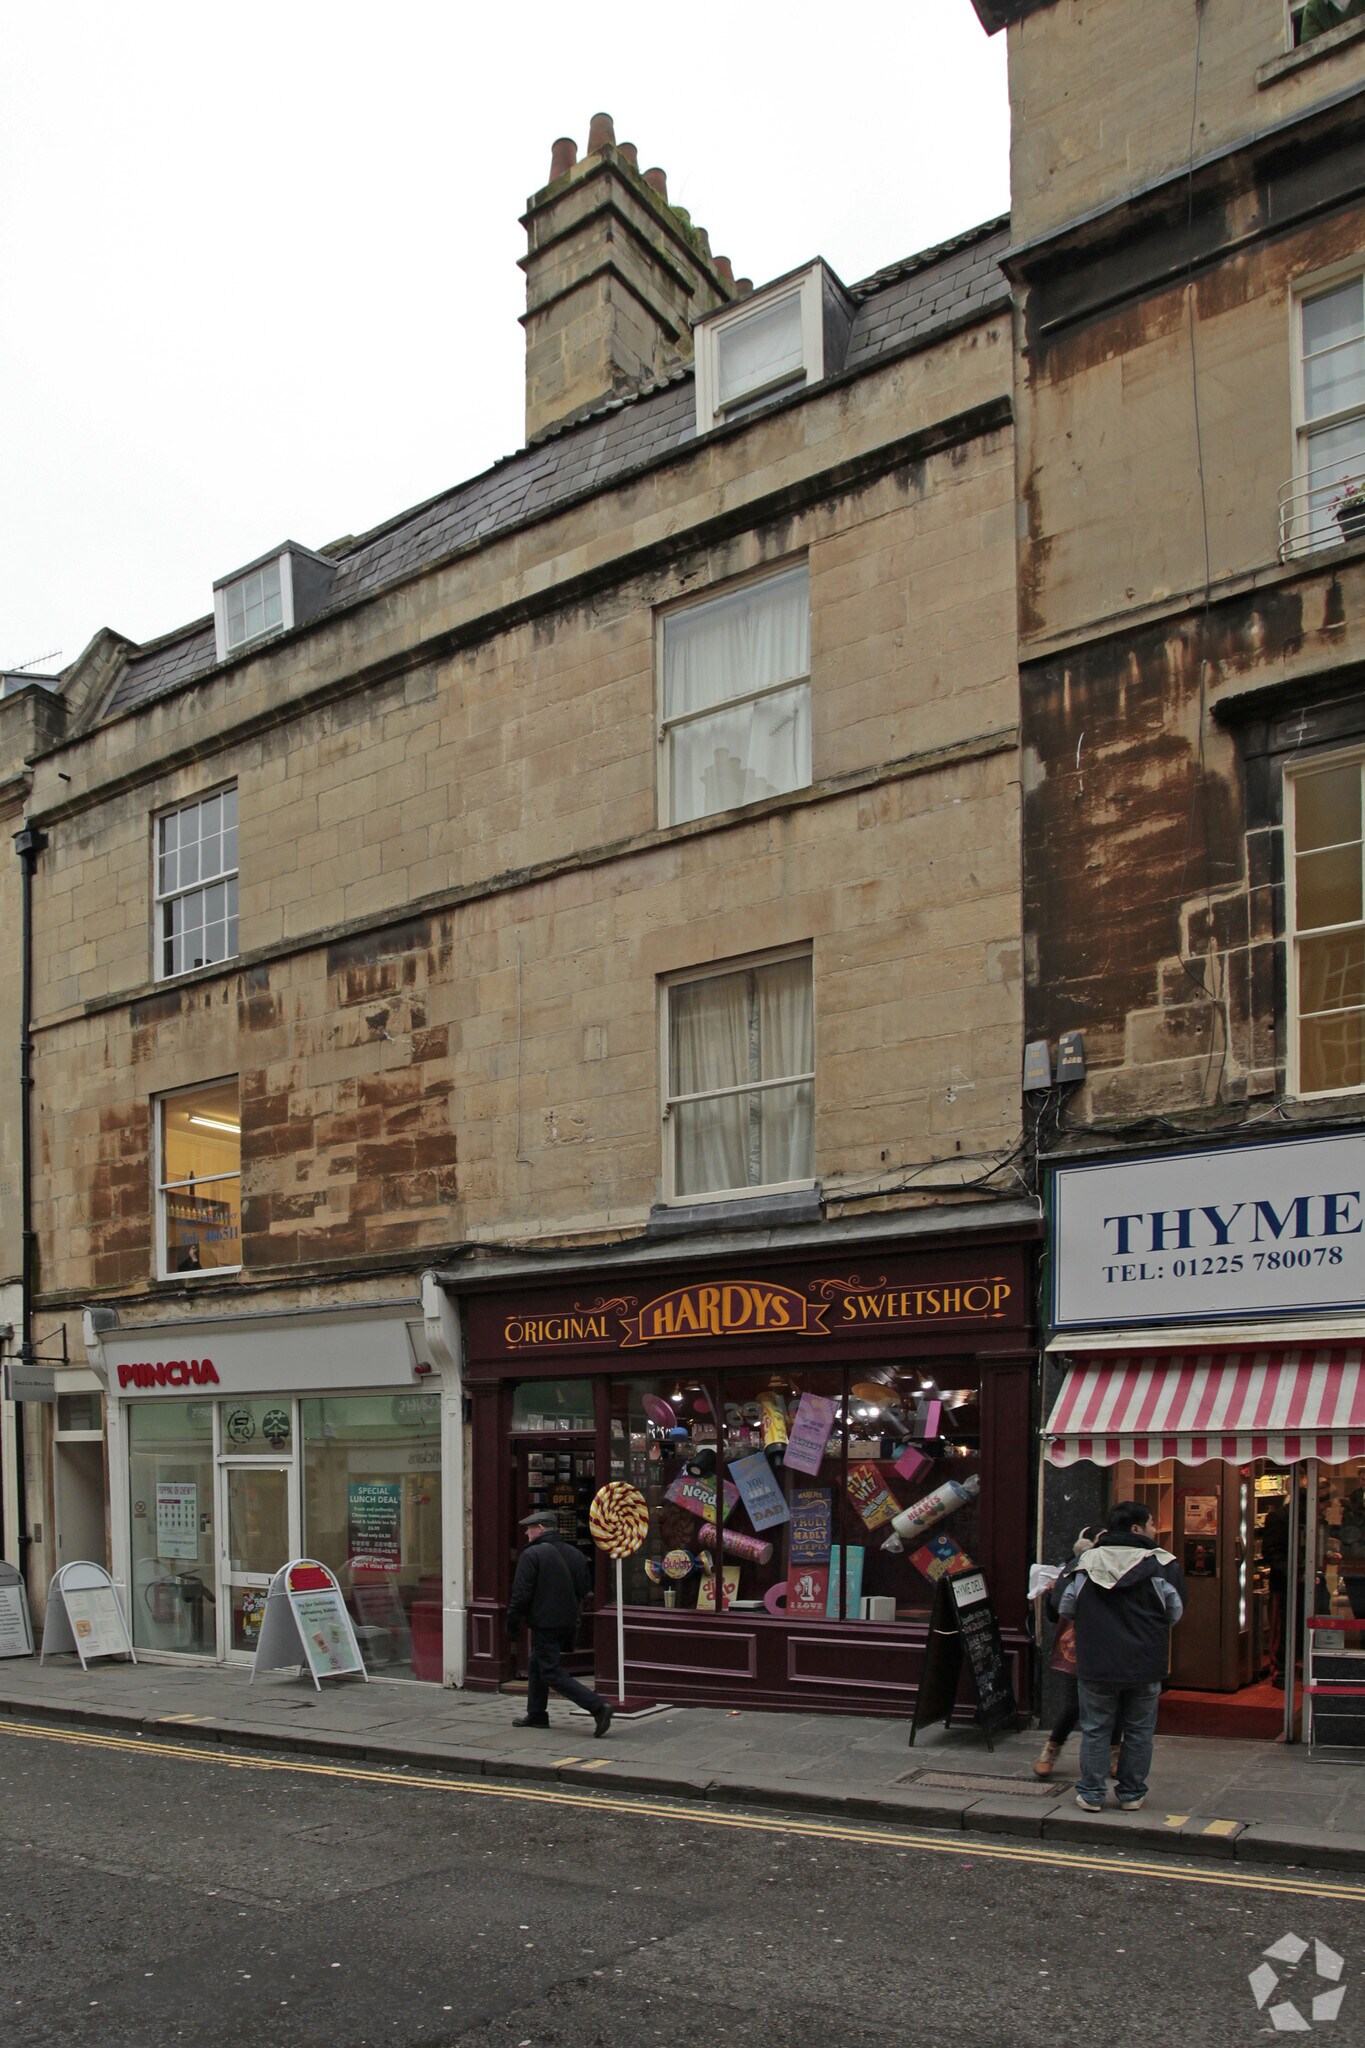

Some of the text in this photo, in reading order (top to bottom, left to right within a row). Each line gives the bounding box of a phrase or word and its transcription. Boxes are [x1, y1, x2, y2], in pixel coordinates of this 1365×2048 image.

[1103, 1191, 1363, 1256] THYME
[1102, 1246, 1344, 1283] TEL: 01225 780078
[504, 1284, 1011, 1344] ORIGINAL HARDYS SWEETSHOP
[358, 1487, 389, 1495] SPECIAL
[378, 1496, 398, 1504] DEAL
[553, 1494, 575, 1504] OPEN
[907, 1495, 942, 1521] HEARTS
[793, 1518, 827, 1527] TRULY
[793, 1530, 828, 1540] MADLY
[791, 1543, 830, 1551] DEEPLY
[797, 1602, 824, 1610] LOVE
